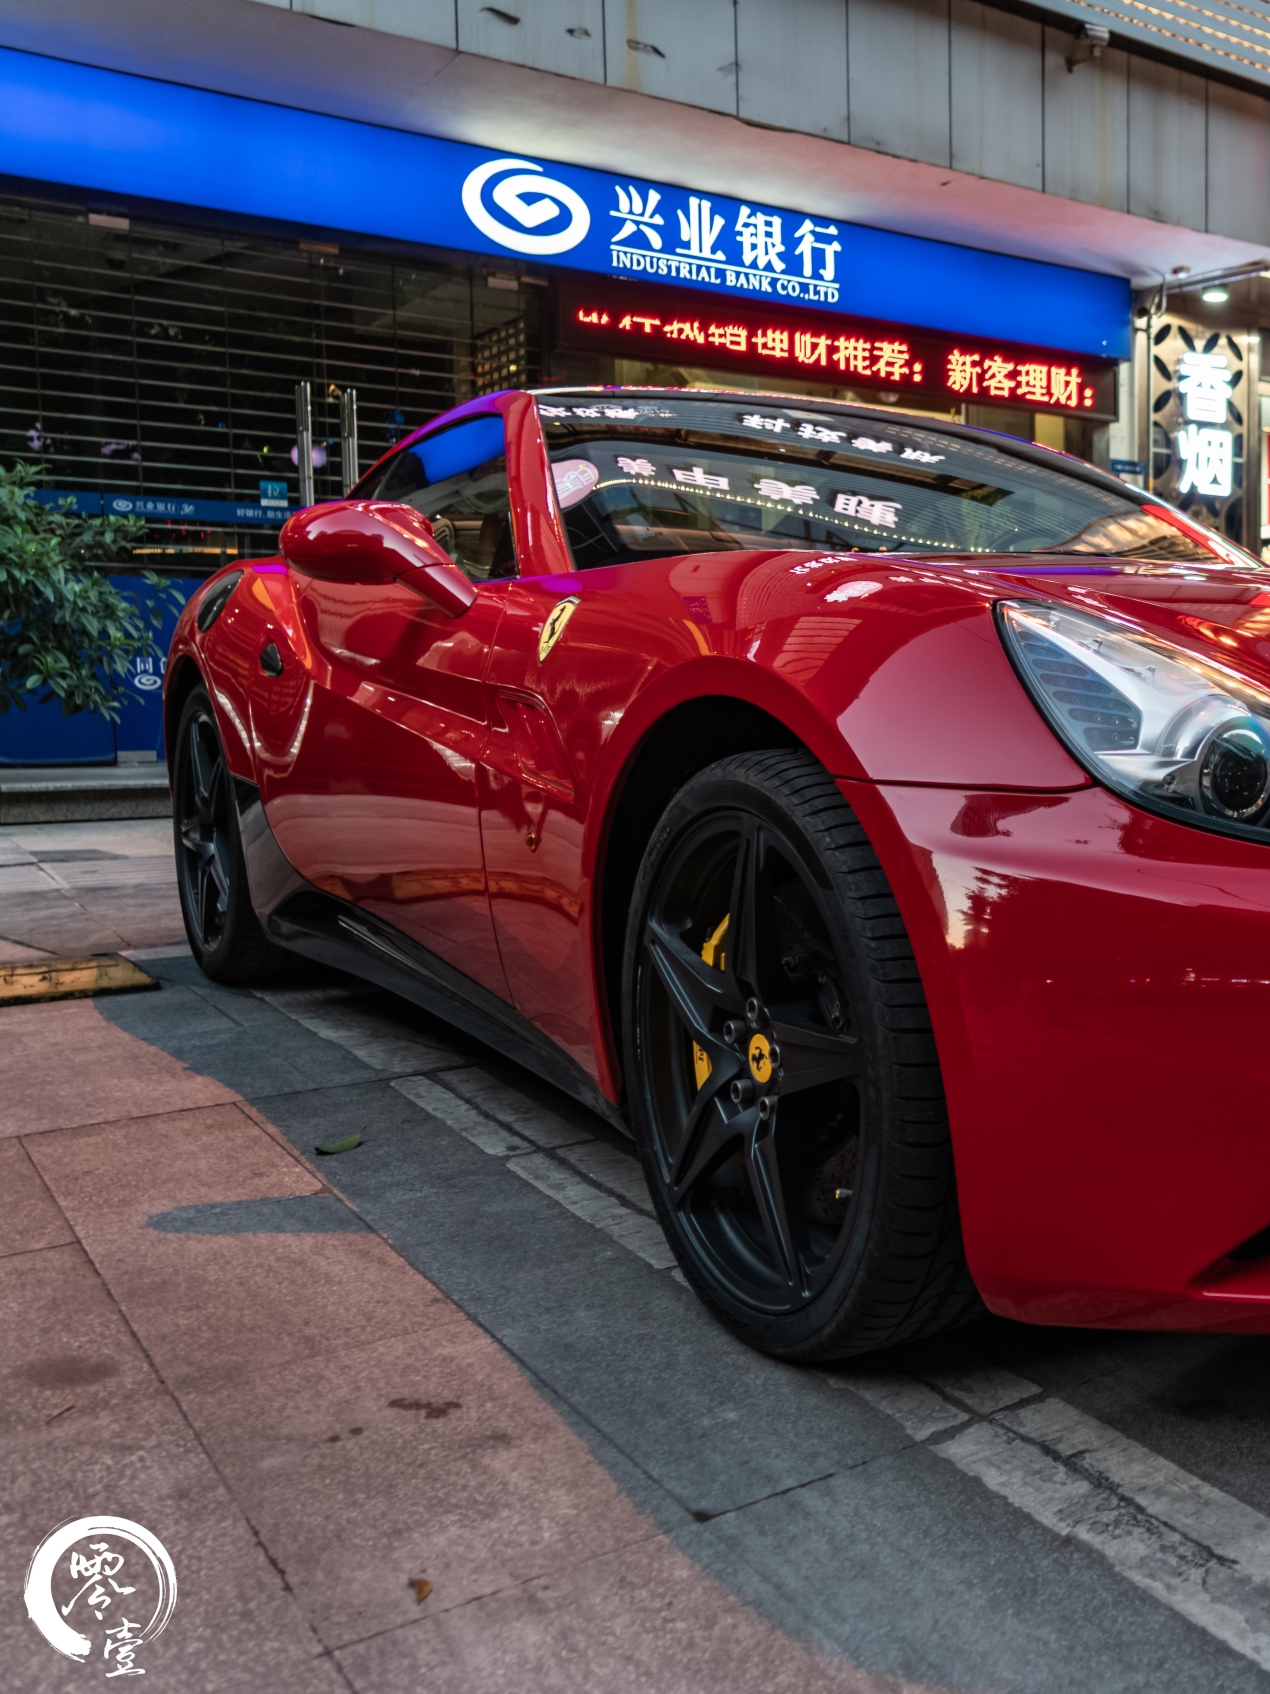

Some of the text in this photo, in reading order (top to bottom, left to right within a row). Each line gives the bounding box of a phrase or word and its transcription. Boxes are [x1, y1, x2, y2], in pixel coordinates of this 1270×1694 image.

[609, 184, 842, 282] 兴业银行
[611, 250, 840, 303] INDUSTRIAL BANK CO.,LTD
[1177, 352, 1233, 497] 香烟
